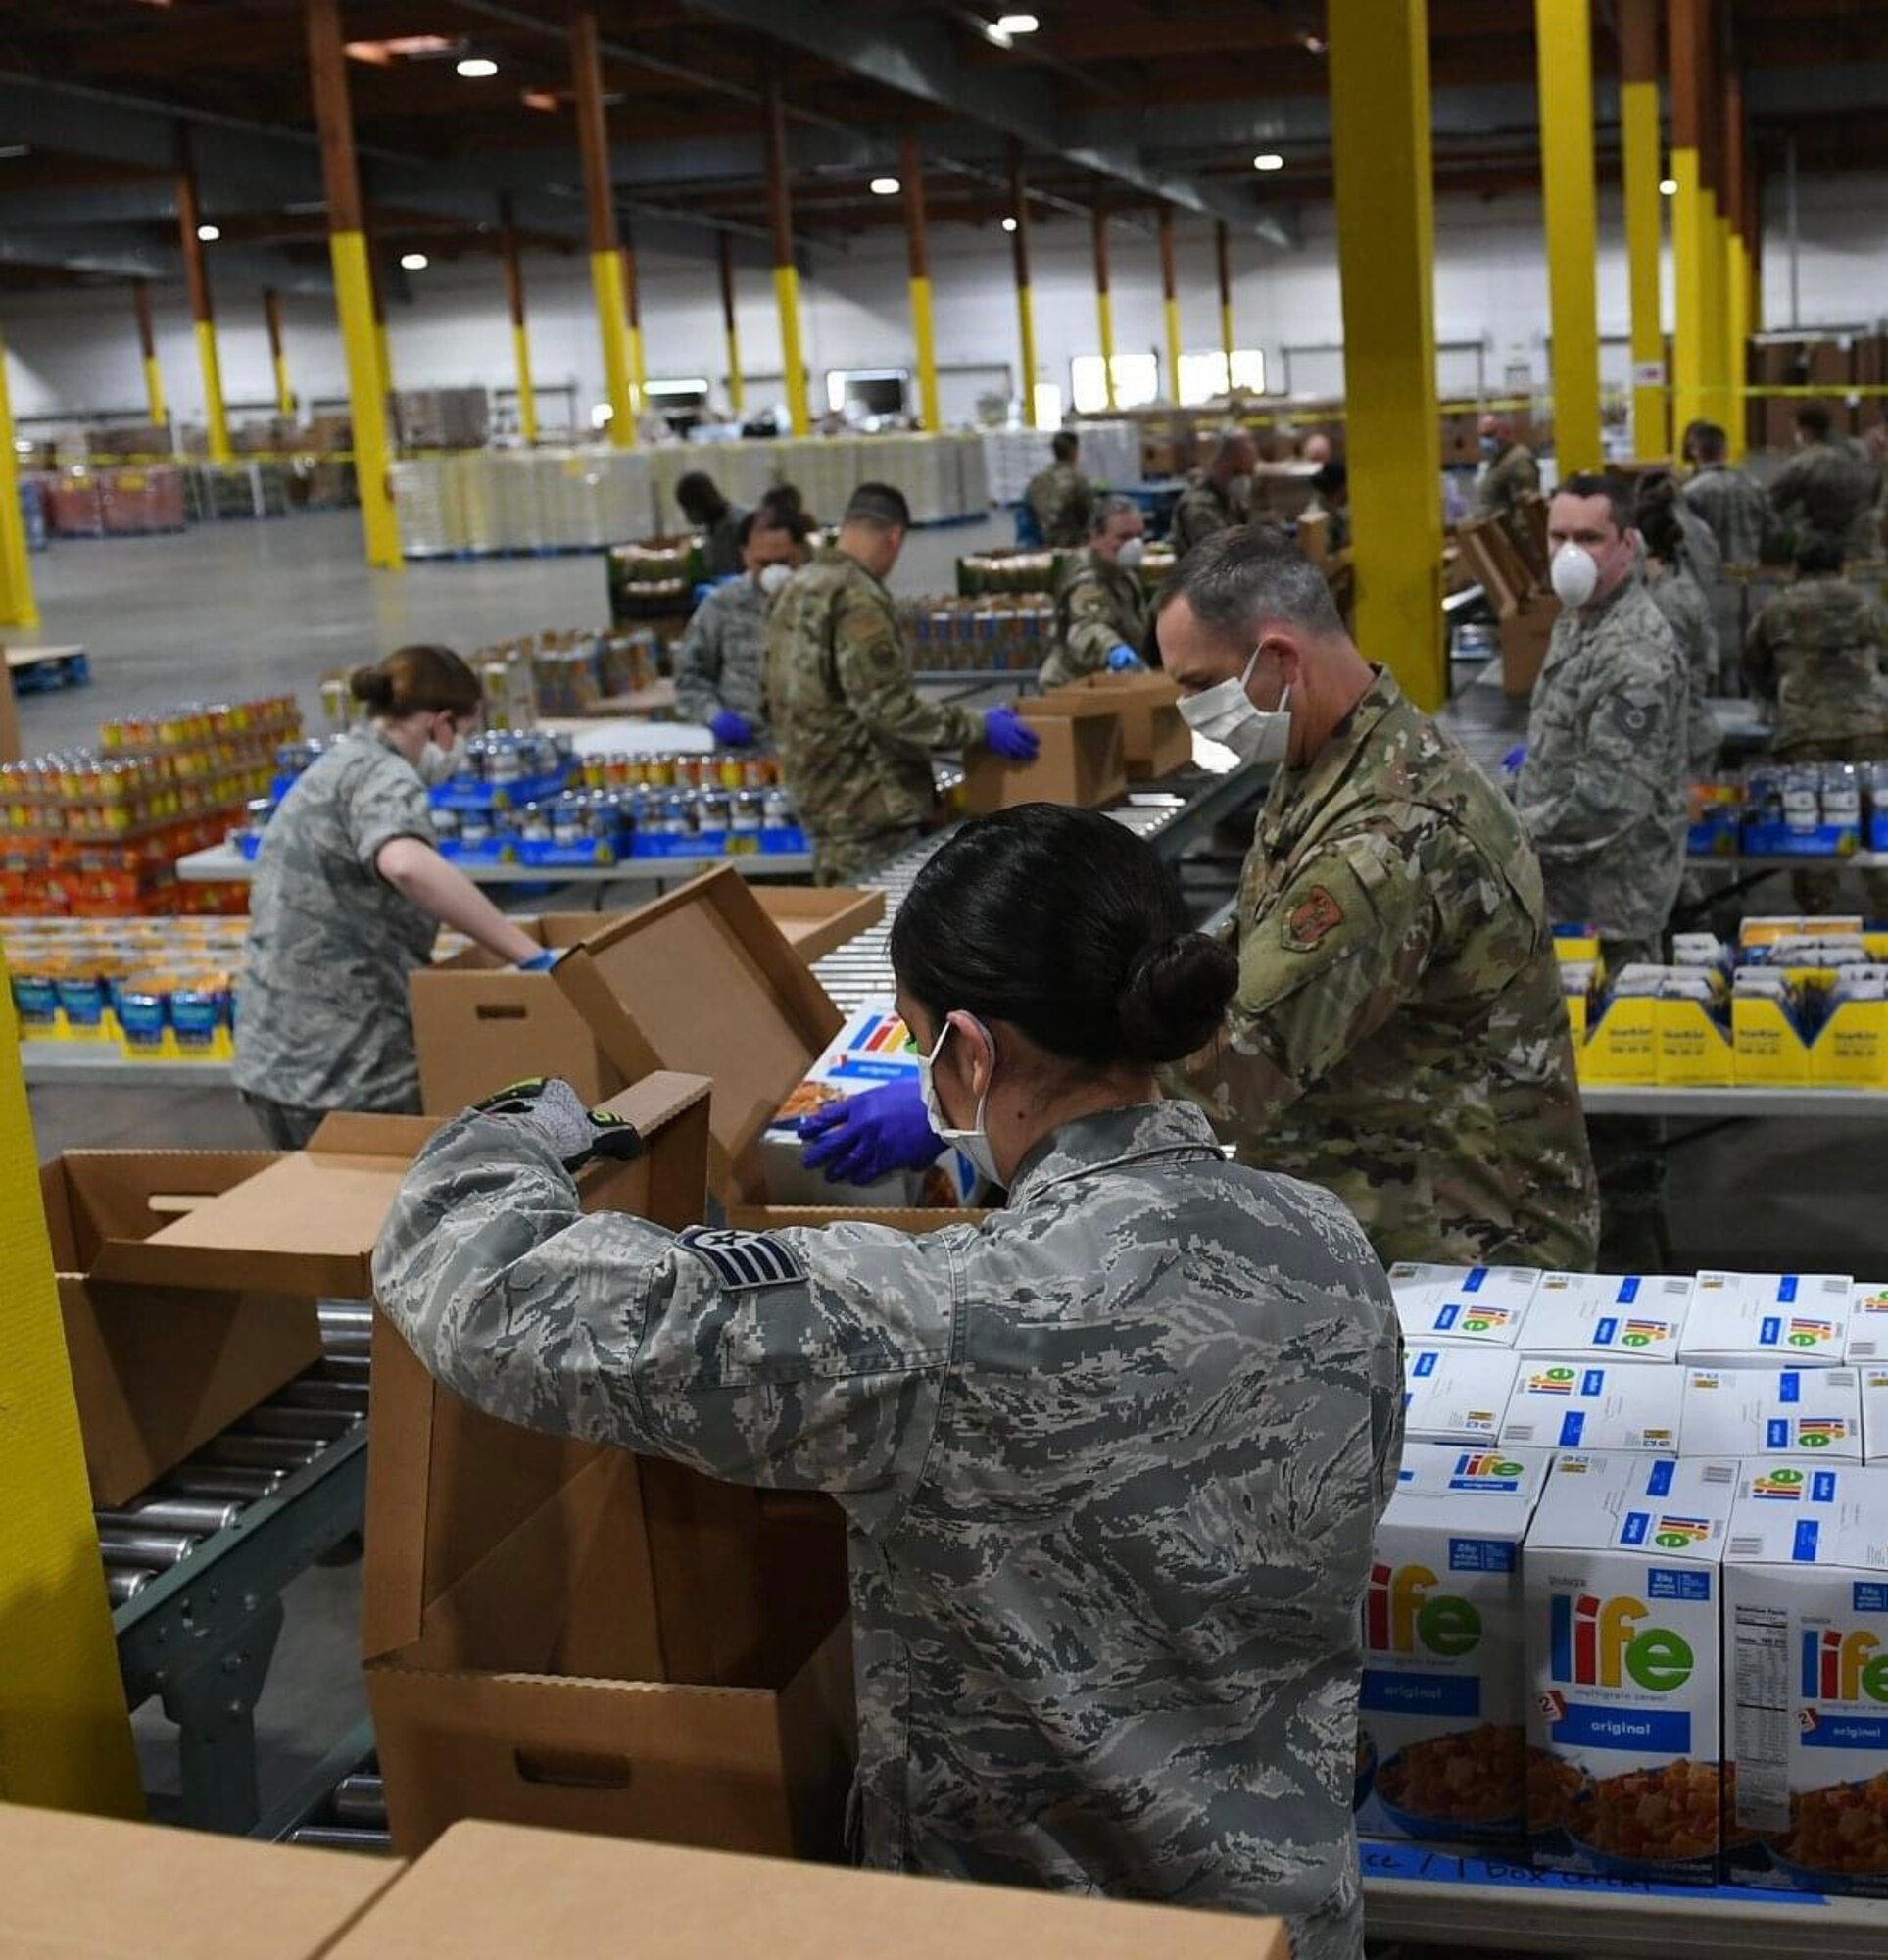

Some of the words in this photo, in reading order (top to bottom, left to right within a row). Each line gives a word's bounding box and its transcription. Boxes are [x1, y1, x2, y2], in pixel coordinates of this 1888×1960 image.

[848, 1015, 919, 1055] lif
[1462, 1305, 1510, 1332] life
[1622, 1318, 1669, 1347] life
[1788, 1317, 1832, 1347] life
[1528, 1367, 1576, 1396] life
[1798, 1418, 1846, 1448] life
[1454, 1454, 1525, 1477] life
[1753, 1468, 1804, 1500] life
[1655, 1514, 1710, 1548] life
[1362, 1563, 1482, 1657] ife
[1551, 1593, 1694, 1691] life
[1384, 1685, 1443, 1700] original
[1591, 1721, 1651, 1736] original
[1833, 1727, 1881, 1739] original
